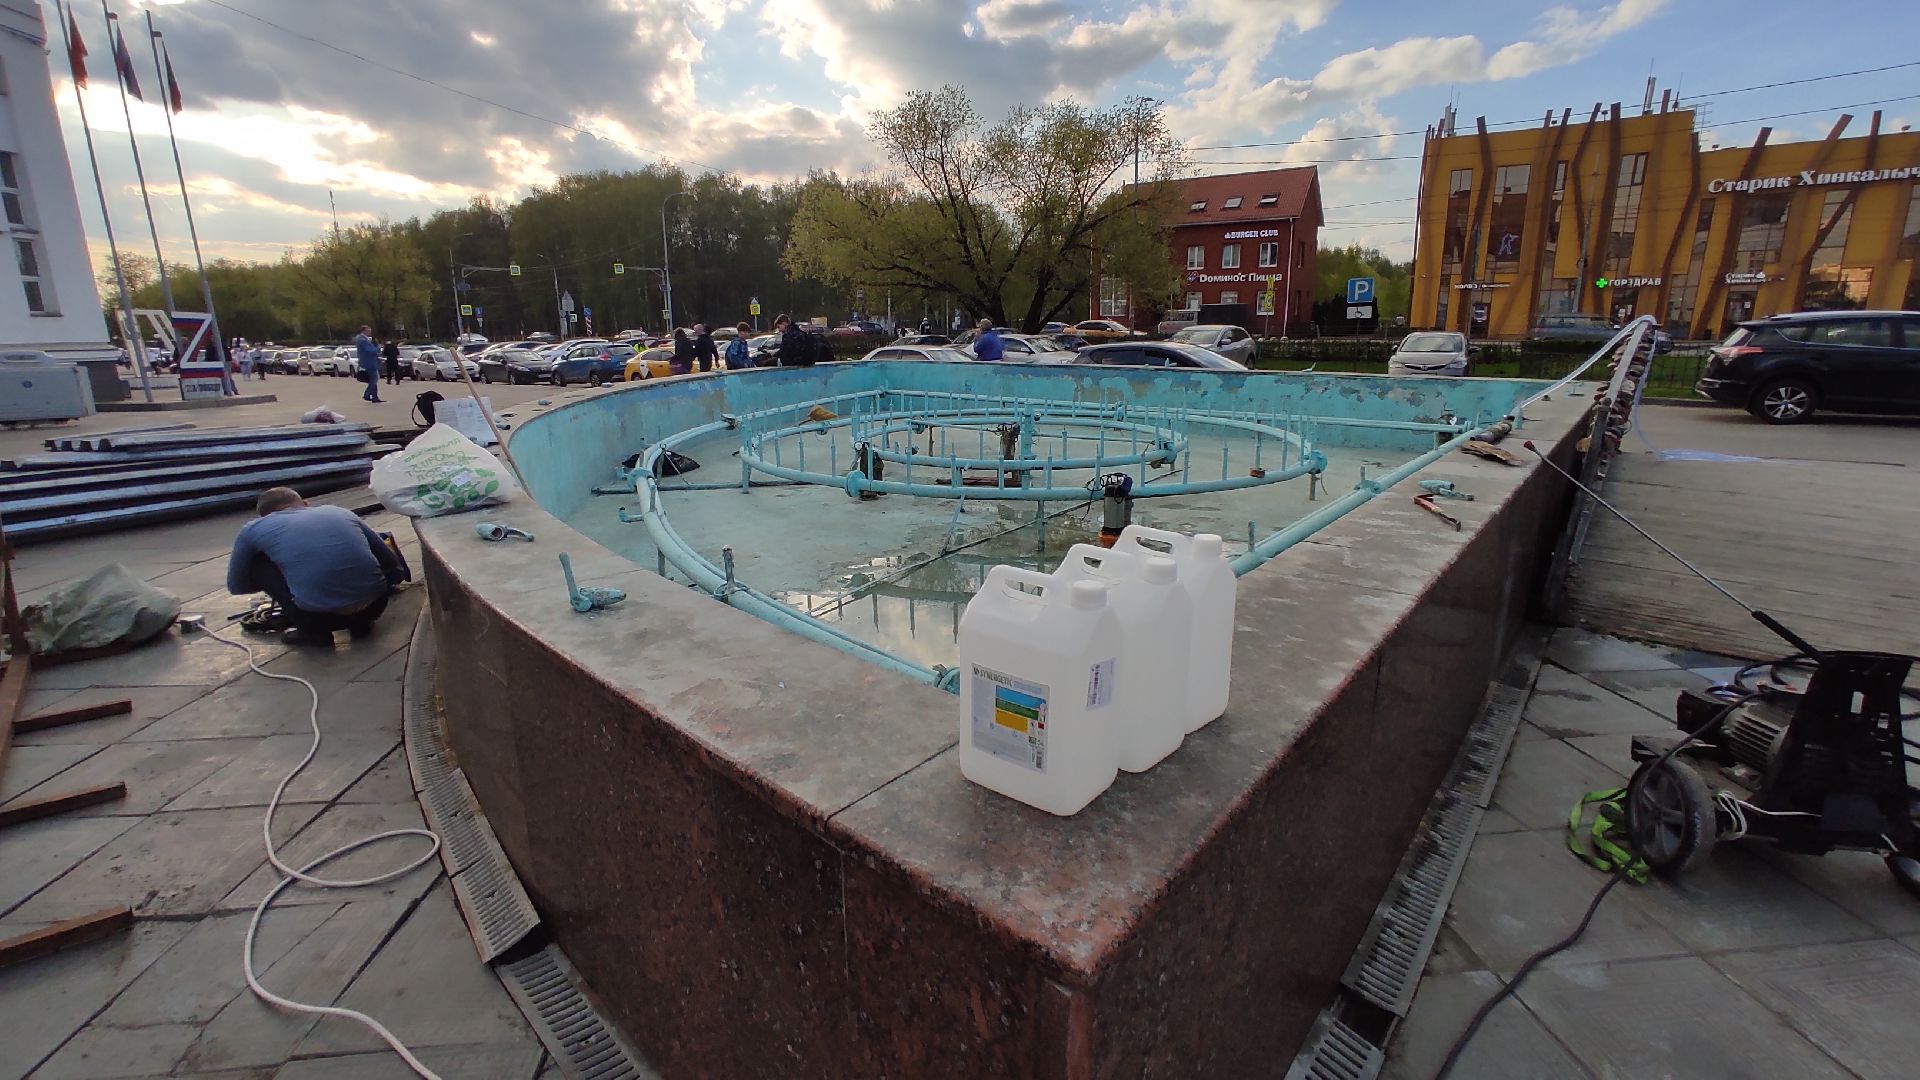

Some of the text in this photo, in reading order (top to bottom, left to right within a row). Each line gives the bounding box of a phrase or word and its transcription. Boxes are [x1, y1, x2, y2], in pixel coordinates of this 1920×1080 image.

[1708, 176, 1791, 194] Старик
[1231, 229, 1279, 239] BURGER CLUB
